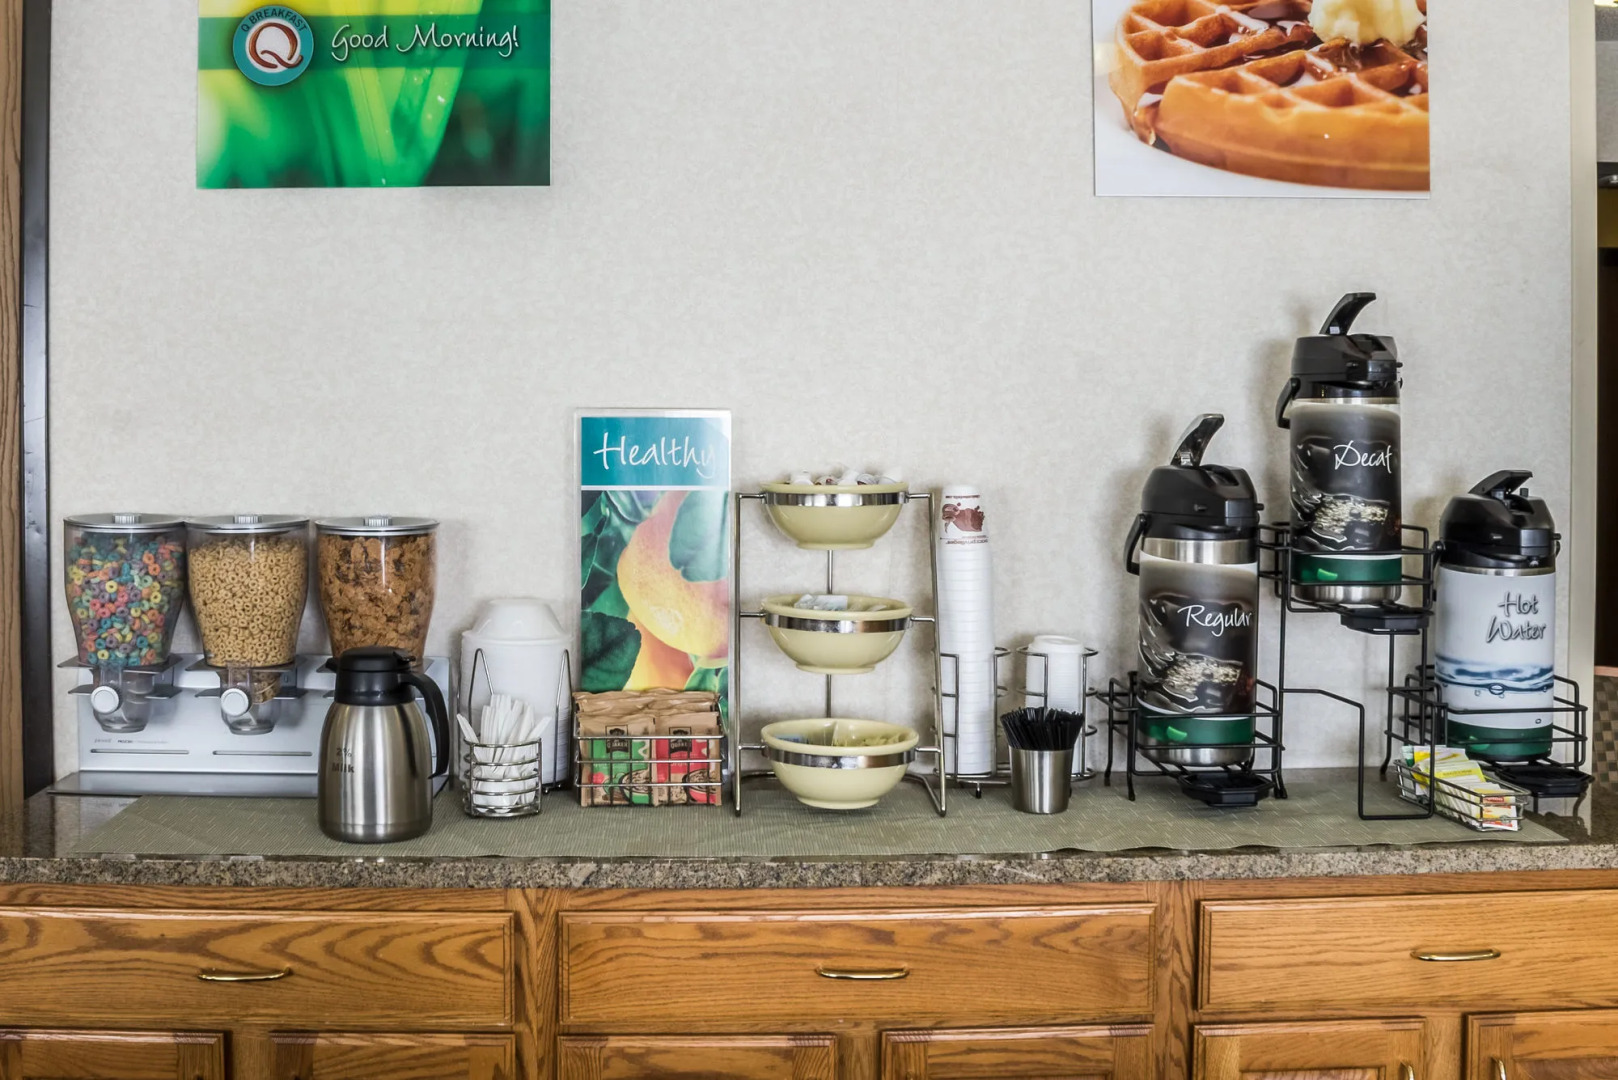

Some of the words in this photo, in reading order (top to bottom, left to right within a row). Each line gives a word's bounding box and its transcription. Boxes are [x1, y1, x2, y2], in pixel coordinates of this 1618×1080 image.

[240, 24, 250, 33] Q
[248, 8, 308, 32] BREAKFAST
[249, 22, 304, 69] Q
[331, 24, 389, 62] Good
[396, 22, 520, 58] Morning!
[593, 431, 716, 480] Healthy
[1333, 439, 1393, 474] Decaf
[1177, 604, 1253, 637] Regular
[1497, 591, 1540, 617] Hot
[1485, 616, 1547, 644] Water
